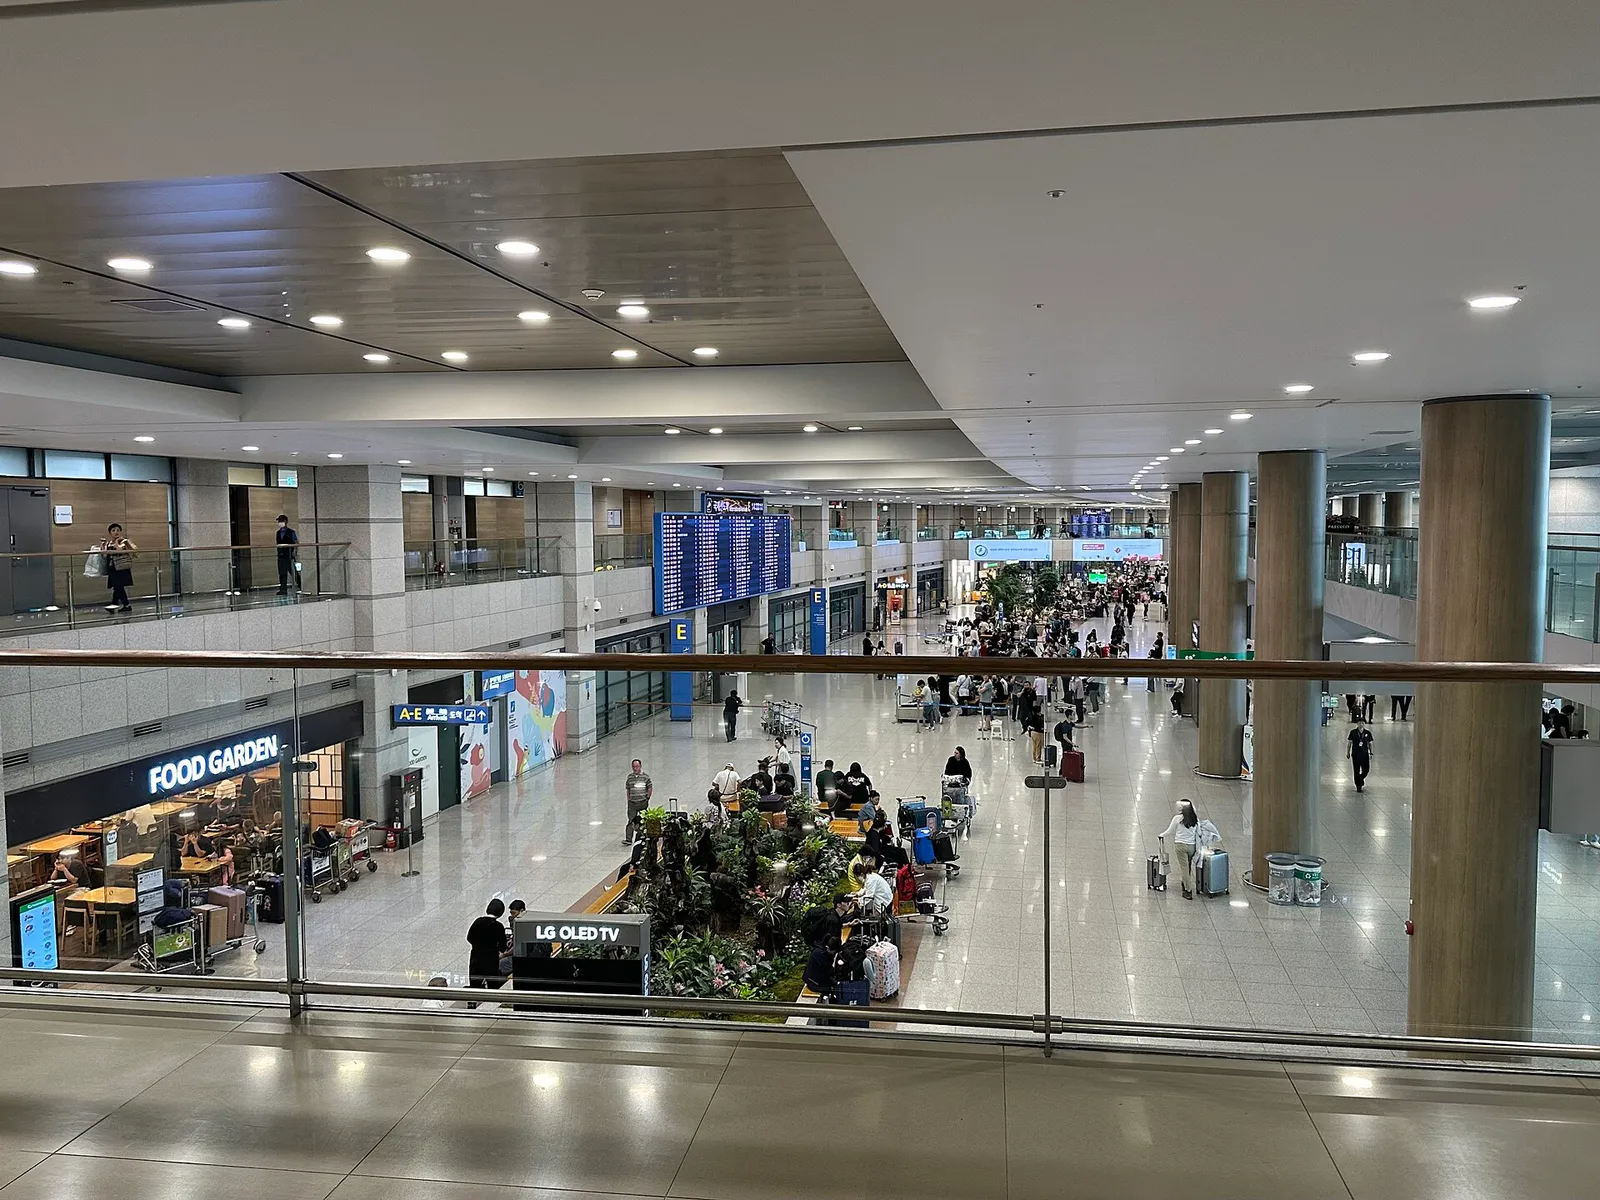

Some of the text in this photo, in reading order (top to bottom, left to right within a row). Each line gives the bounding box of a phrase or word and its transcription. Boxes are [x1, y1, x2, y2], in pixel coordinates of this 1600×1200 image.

[814, 591, 822, 603] E
[676, 623, 687, 640] E
[400, 708, 422, 720] A-E
[149, 735, 278, 794] FOOD GARDEN
[536, 926, 620, 941] LG OLED TV
